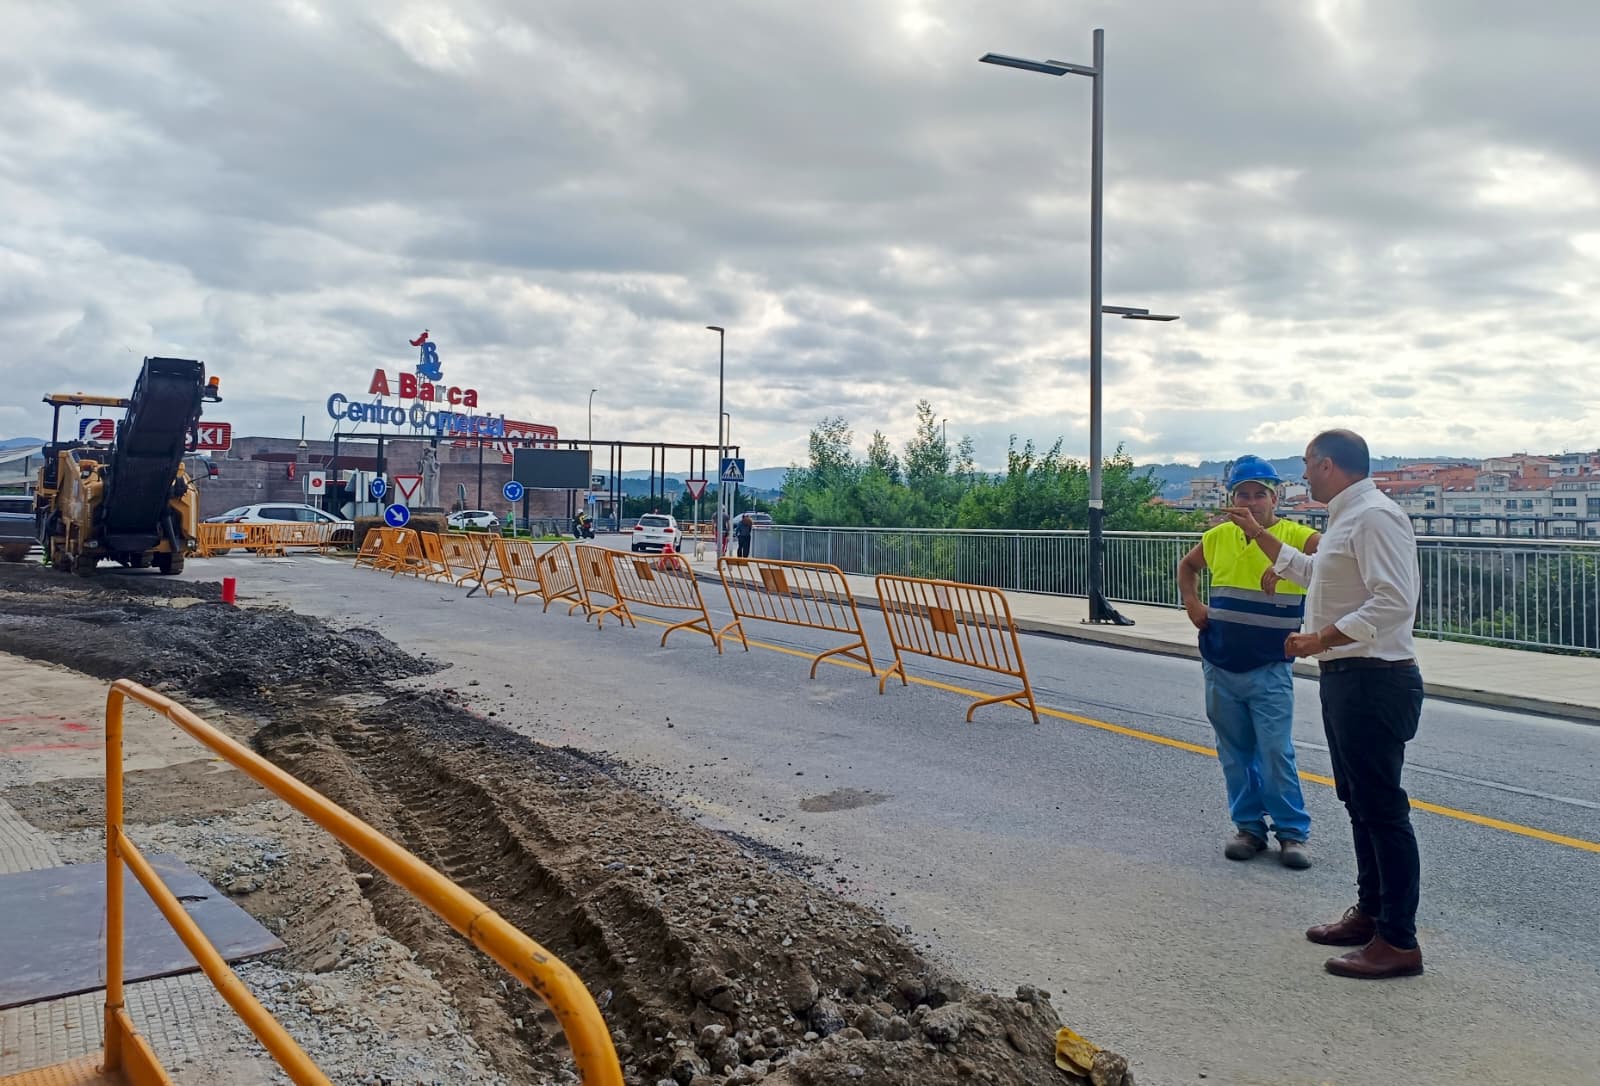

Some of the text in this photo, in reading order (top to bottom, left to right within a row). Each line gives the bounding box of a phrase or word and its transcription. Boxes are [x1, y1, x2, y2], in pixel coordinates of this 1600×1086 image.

[368, 368, 478, 408] A Barca
[327, 392, 503, 436] Centro Comercial
